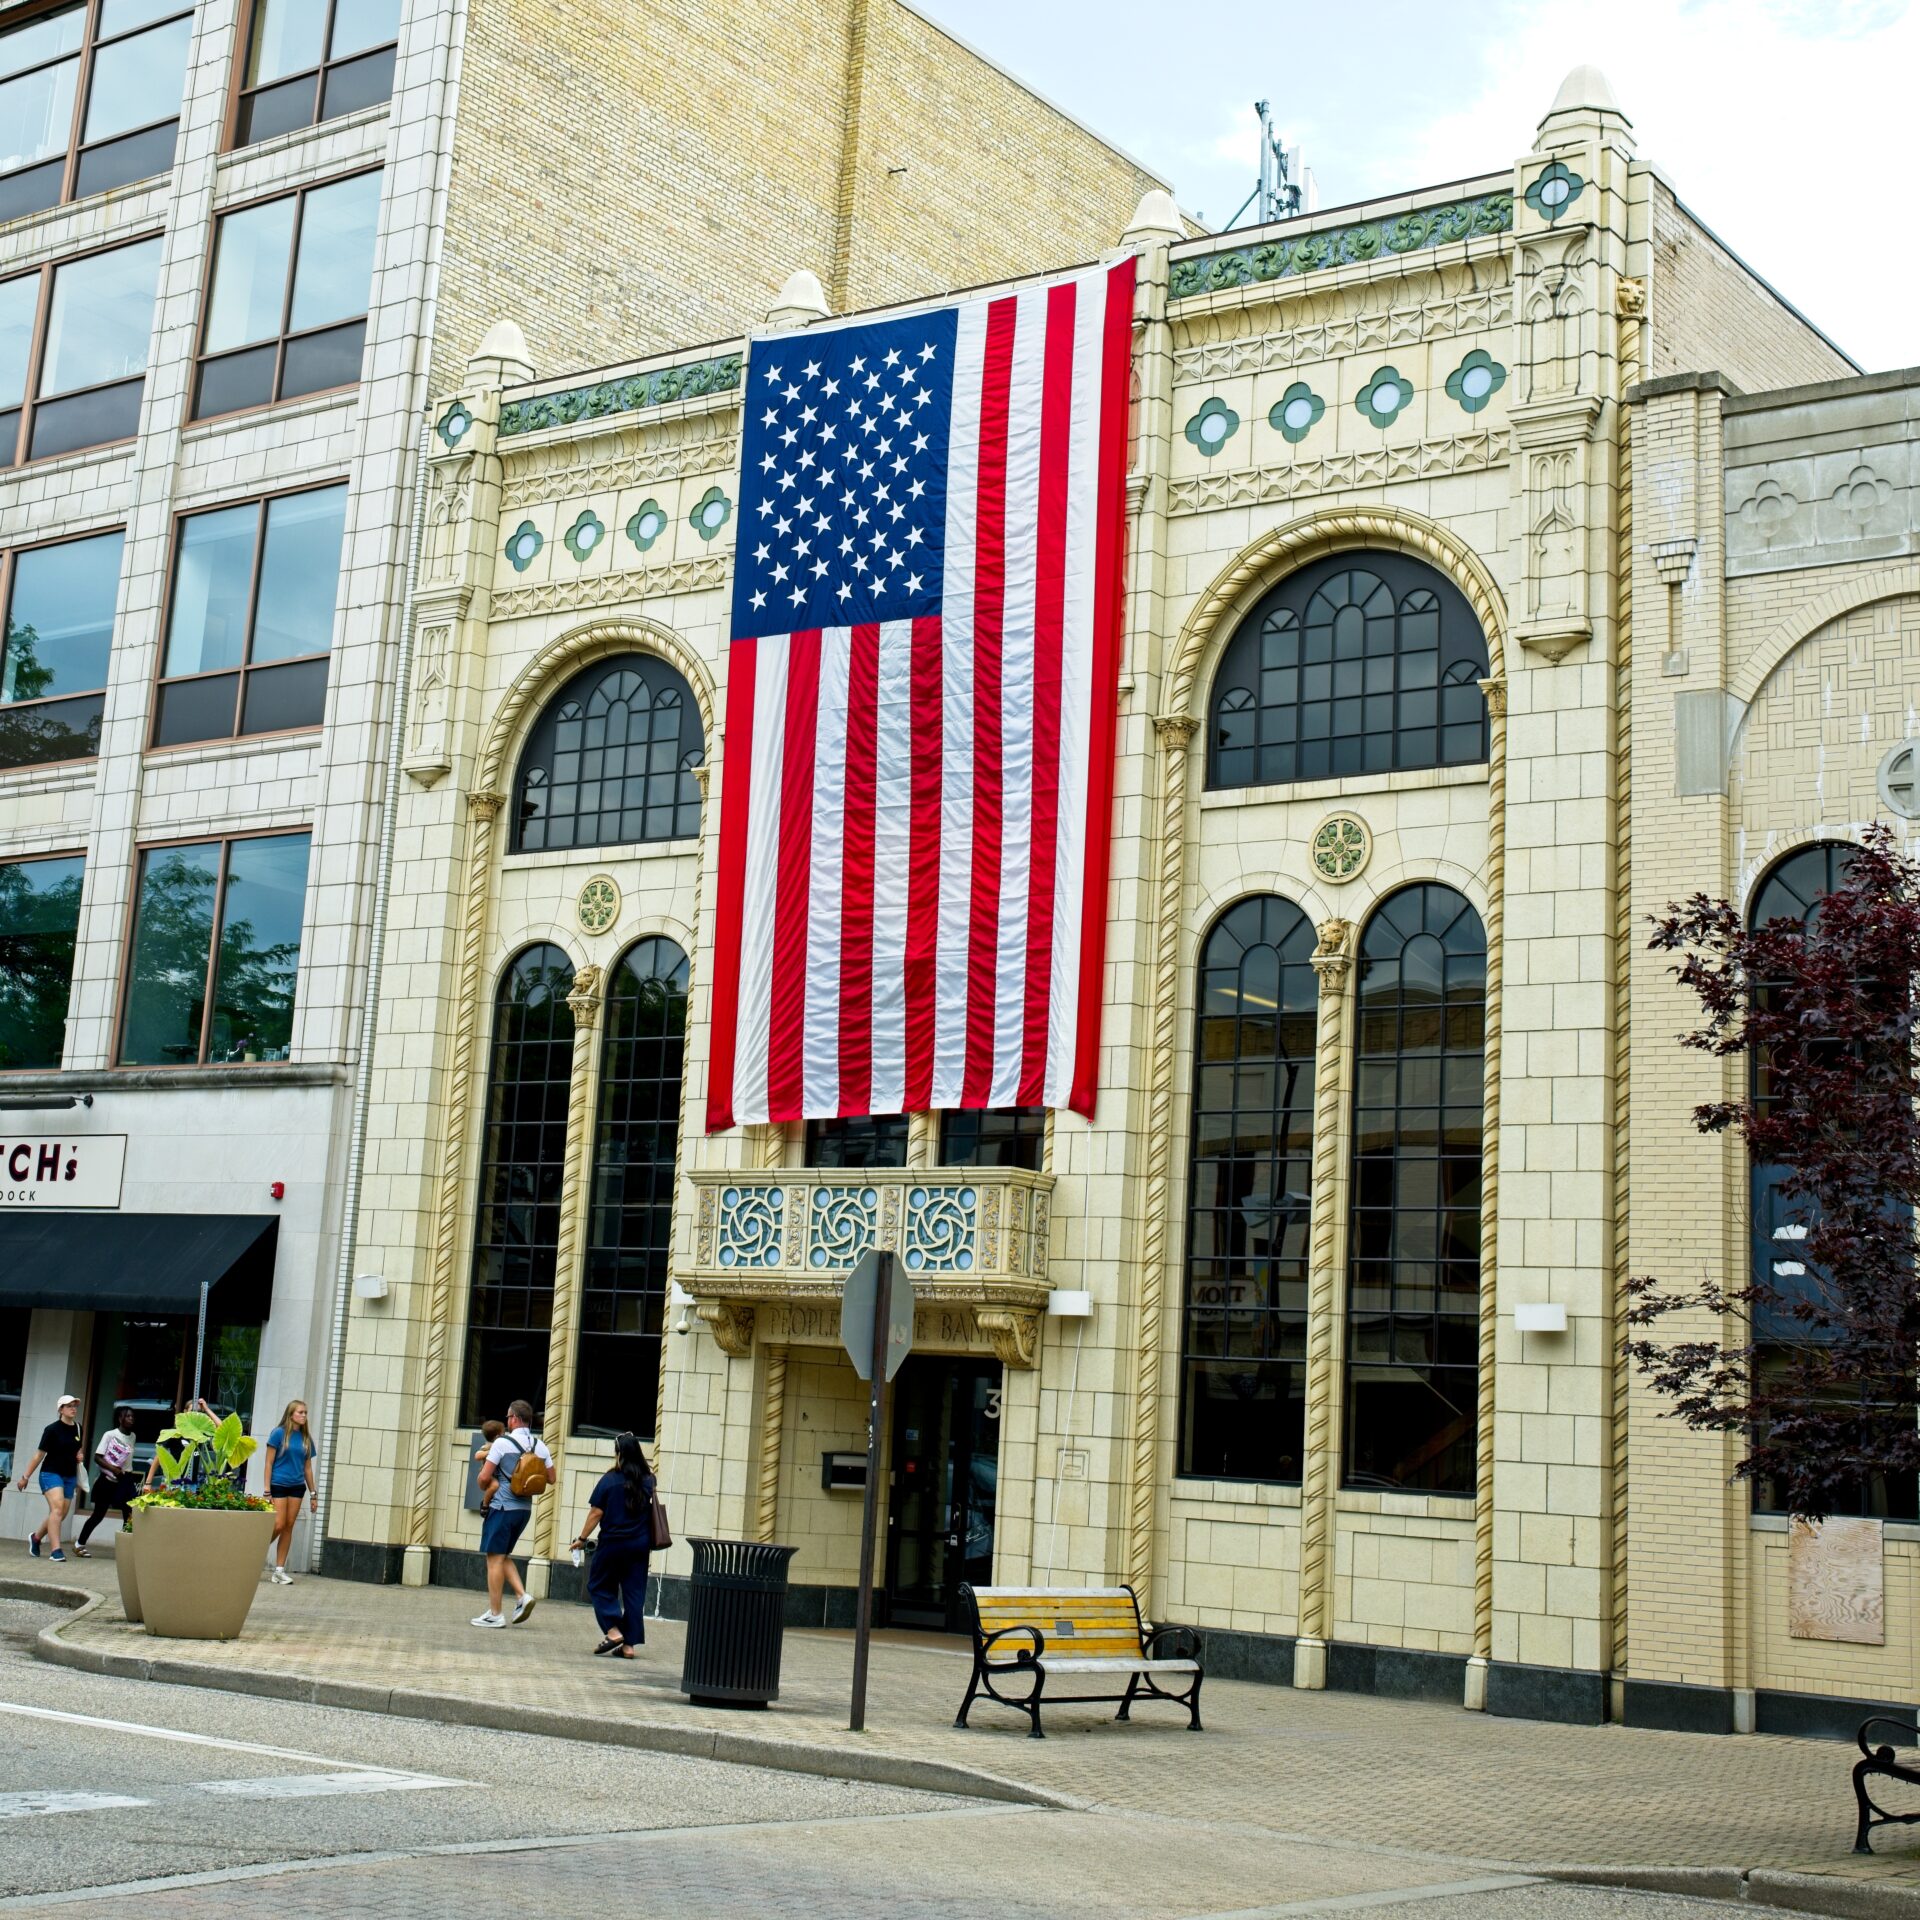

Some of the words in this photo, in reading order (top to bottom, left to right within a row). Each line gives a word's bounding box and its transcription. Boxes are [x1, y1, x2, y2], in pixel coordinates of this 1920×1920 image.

[0, 1144, 79, 1182] CH's
[941, 1308, 993, 1343] BAN
[983, 1388, 1001, 1419] 3
